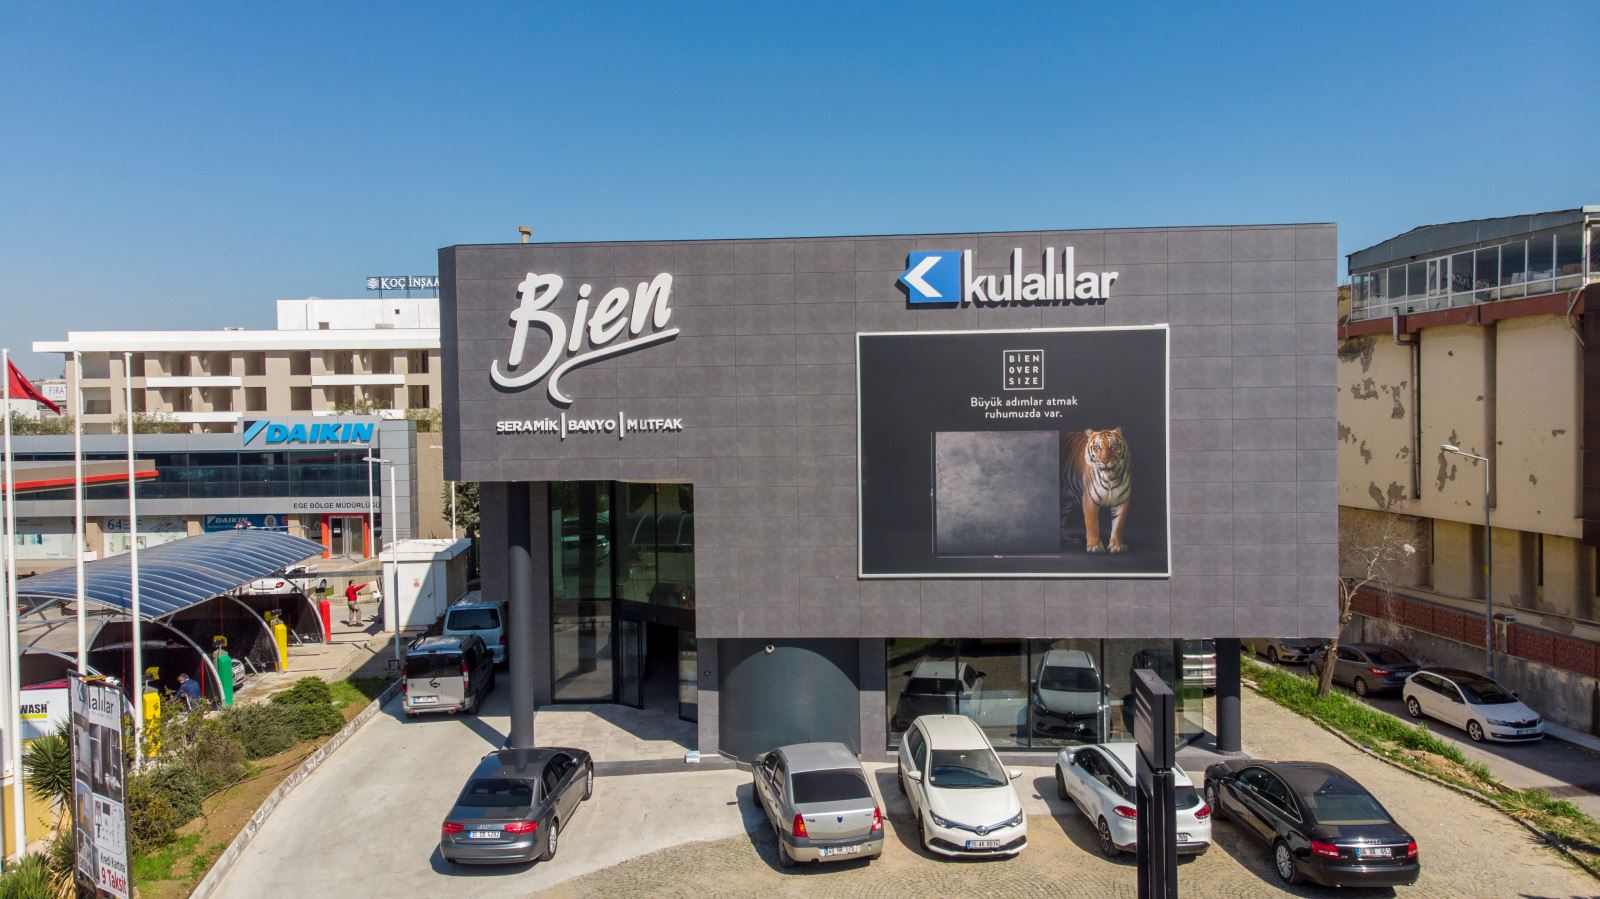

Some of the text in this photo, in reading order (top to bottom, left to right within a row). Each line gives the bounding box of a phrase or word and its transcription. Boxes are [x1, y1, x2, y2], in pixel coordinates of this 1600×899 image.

[963, 246, 1119, 302] kulalılar
[381, 277, 406, 290] KOÇ
[490, 272, 676, 390] Bien
[1009, 366, 1039, 374] OVER
[1009, 377, 1039, 385] SIZE
[49, 386, 66, 395] FIRA
[970, 395, 1078, 410] Büyük adımlar atmak
[985, 408, 1063, 419] ruhumuzda var.
[496, 417, 683, 432] SERAMİK BANYO MUTFAK
[265, 422, 375, 444] DAIKIN
[309, 501, 334, 509] BÖLGE
[107, 518, 122, 530] 64
[20, 703, 48, 714] WASH
[101, 866, 127, 895] 9 Taksit
